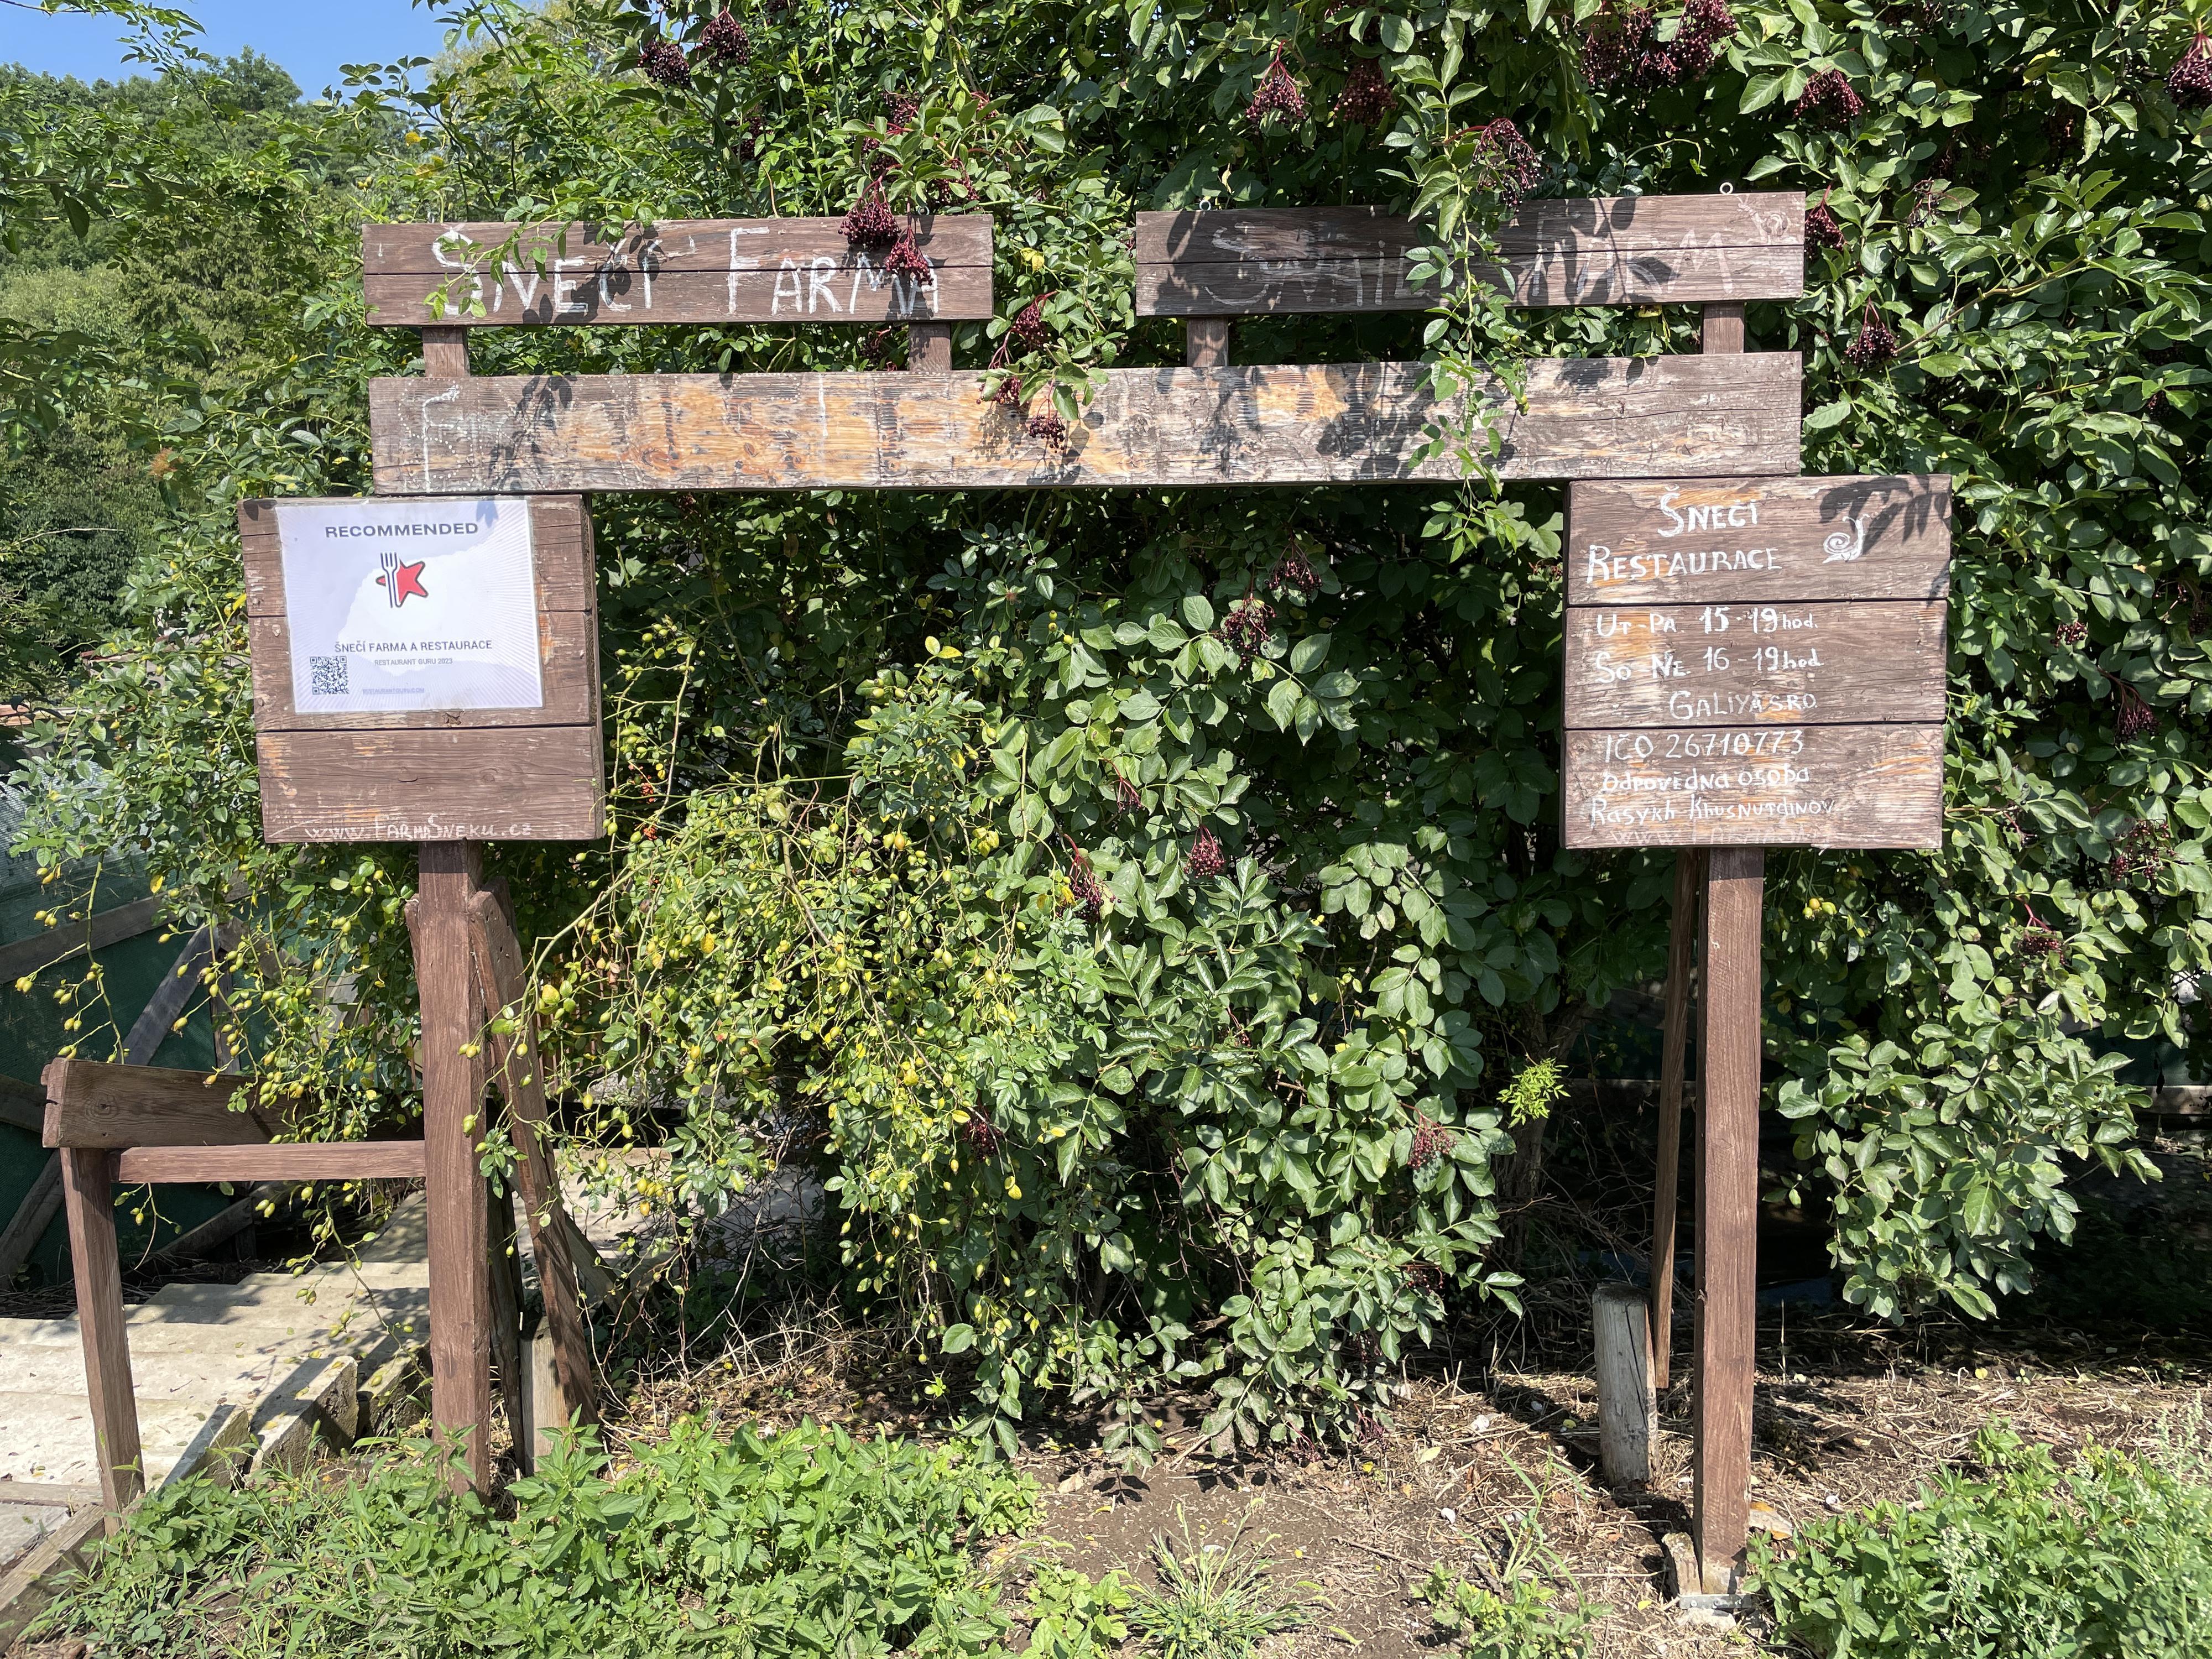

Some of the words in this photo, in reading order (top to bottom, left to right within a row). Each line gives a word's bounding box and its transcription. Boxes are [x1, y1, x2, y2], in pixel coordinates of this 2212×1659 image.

[728, 226, 939, 315] FARMA
[325, 523, 478, 538] RECOMMENDED
[1587, 544, 1783, 584] RESTAURACE
[335, 640, 366, 653] ŠNEČÍ
[369, 642, 408, 653] FARMA
[410, 641, 418, 651] A
[420, 640, 493, 651] RESTAURACE
[1604, 733, 1653, 763] IČO
[1665, 729, 1804, 758] 26710773
